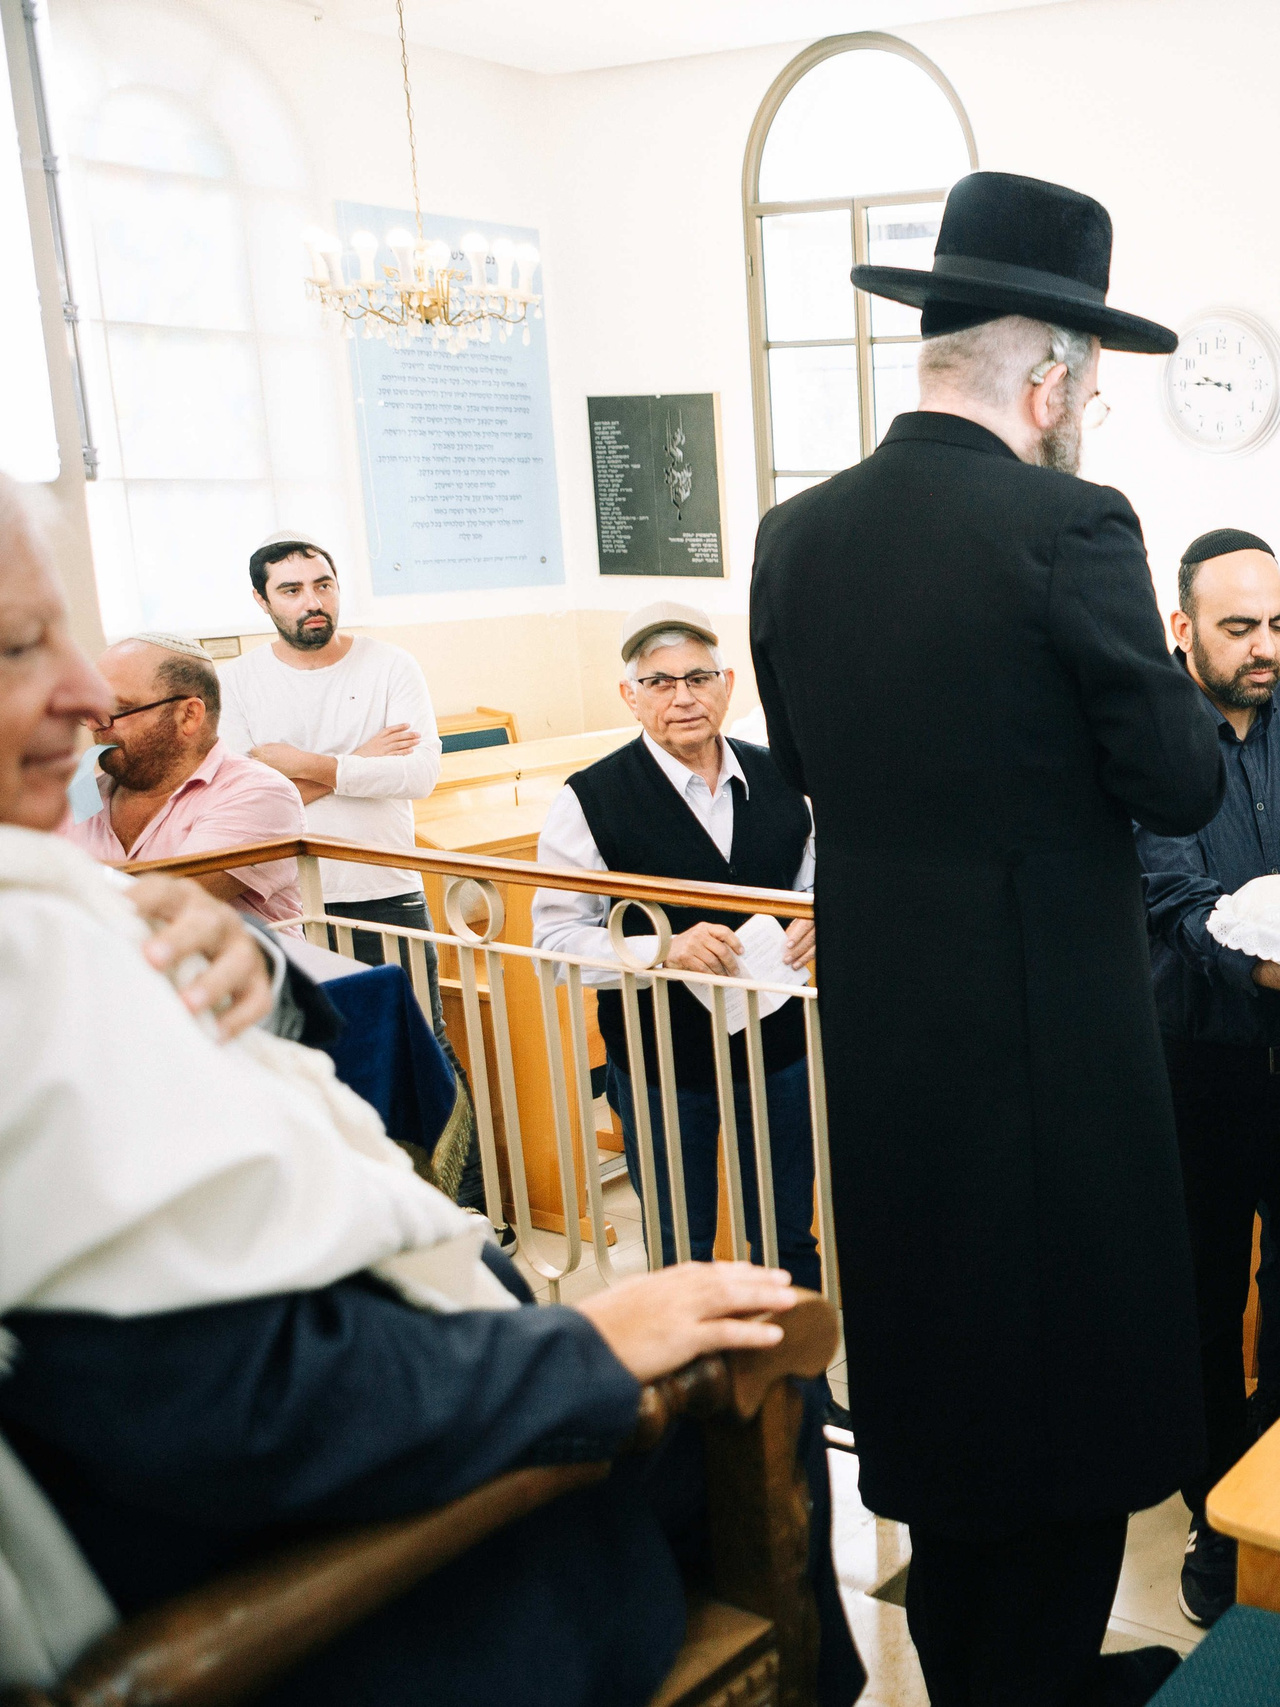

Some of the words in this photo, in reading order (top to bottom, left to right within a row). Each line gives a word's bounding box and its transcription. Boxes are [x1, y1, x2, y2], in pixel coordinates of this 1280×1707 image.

[1199, 342, 1208, 355] 11
[1216, 337, 1227, 350] 12
[1185, 358, 1195, 370] 10
[1216, 421, 1224, 433] 6
